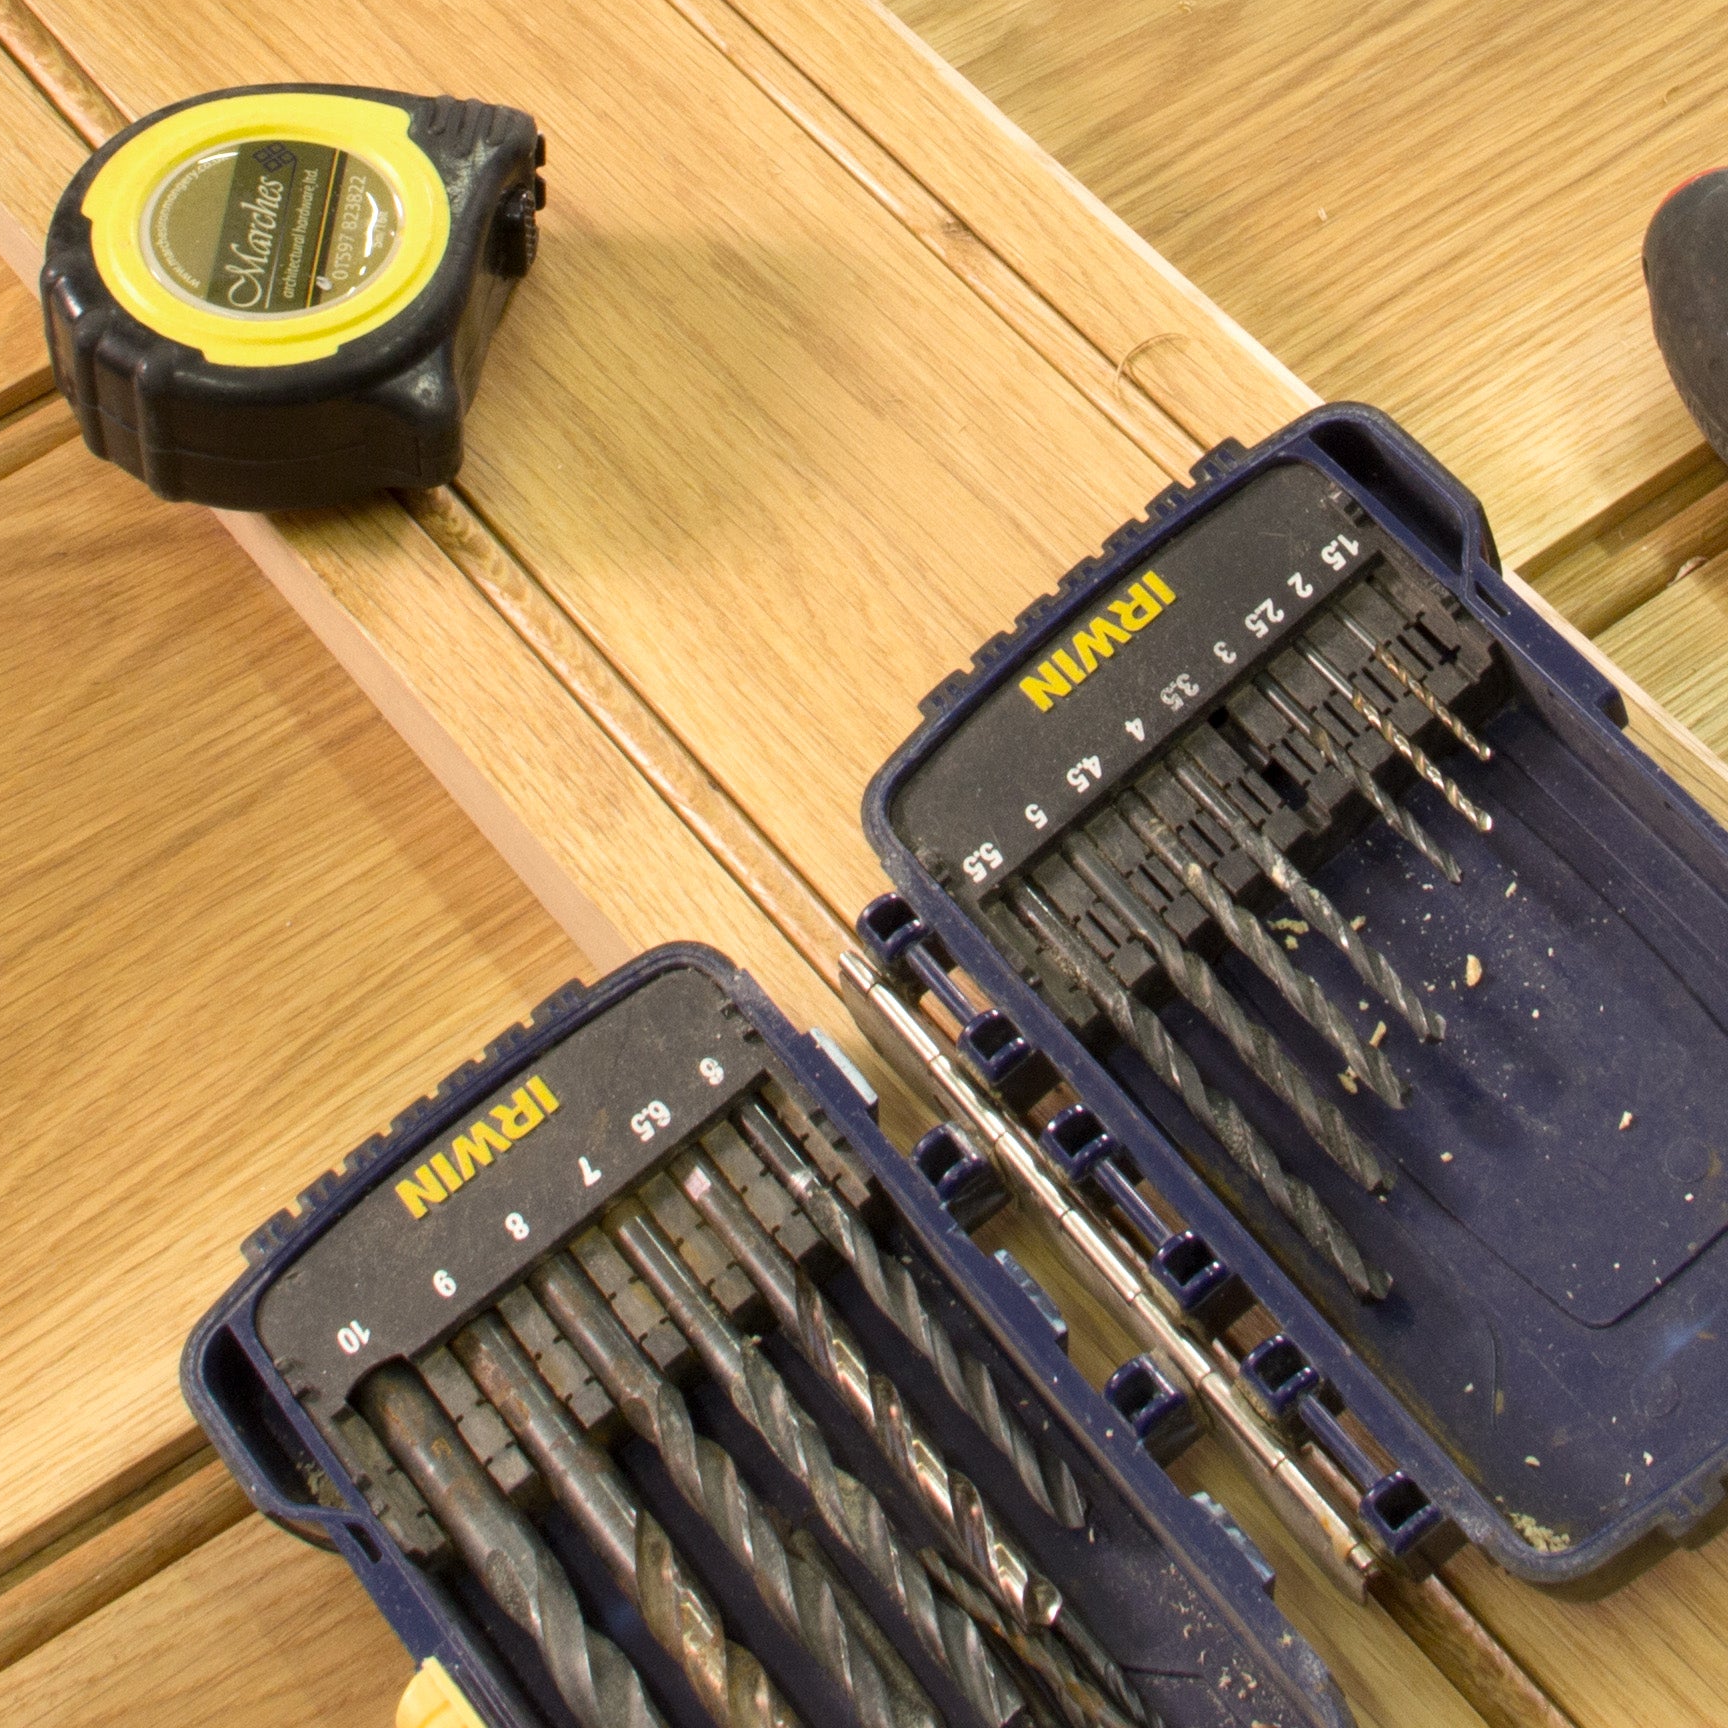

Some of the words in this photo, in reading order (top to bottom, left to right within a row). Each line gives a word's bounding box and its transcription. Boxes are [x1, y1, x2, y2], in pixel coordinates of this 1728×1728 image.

[342, 175, 367, 230] 823822
[224, 175, 285, 308] Marches
[283, 229, 306, 299] architectural
[297, 183, 316, 233] hardware
[1321, 533, 1360, 571] 1.5
[1286, 571, 1314, 599] 2
[1246, 598, 1285, 639] 2.5
[1019, 571, 1177, 712] IRWIN
[1212, 641, 1237, 665] 3
[1159, 673, 1200, 712] 3.5
[1125, 717, 1147, 741] 4
[1066, 754, 1103, 793] 4.5
[1024, 803, 1048, 830] 5
[963, 842, 1003, 884] 5.5
[700, 1057, 725, 1086] 6
[630, 1100, 672, 1142] 6.5
[395, 1074, 563, 1220] IRWIN
[577, 1156, 602, 1187] 7
[504, 1212, 530, 1240] 8
[432, 1269, 457, 1298] 9
[337, 1319, 371, 1355] 10
